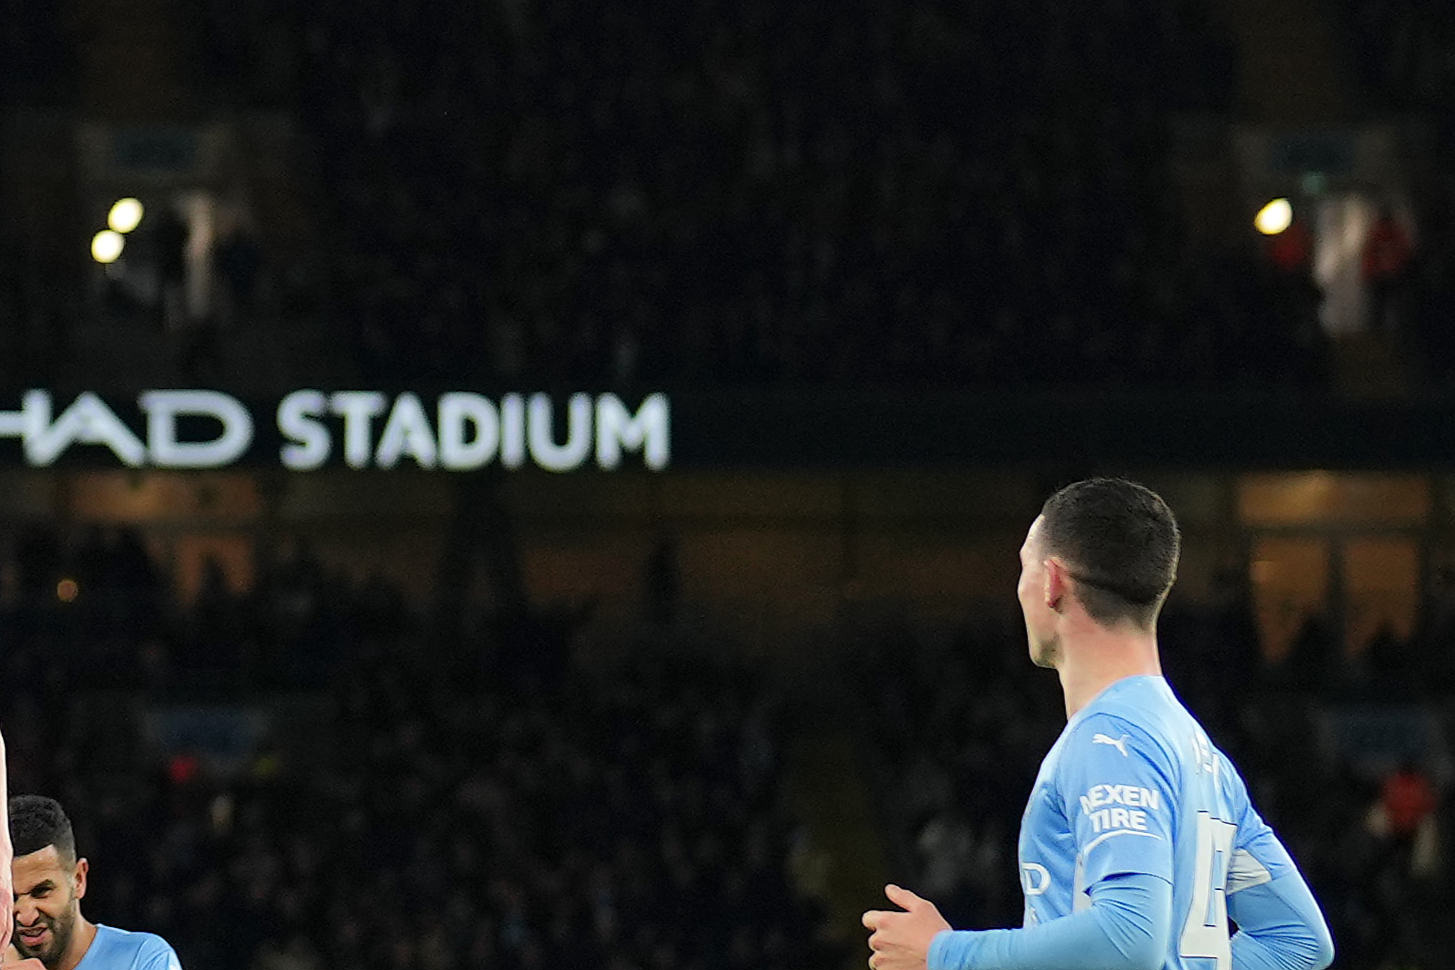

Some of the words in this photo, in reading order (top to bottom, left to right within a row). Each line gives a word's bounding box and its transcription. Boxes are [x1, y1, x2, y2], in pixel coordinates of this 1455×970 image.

[277, 390, 670, 471] STADIUM
[1079, 784, 1159, 815] NEXEN
[1089, 807, 1148, 833] TIRE
